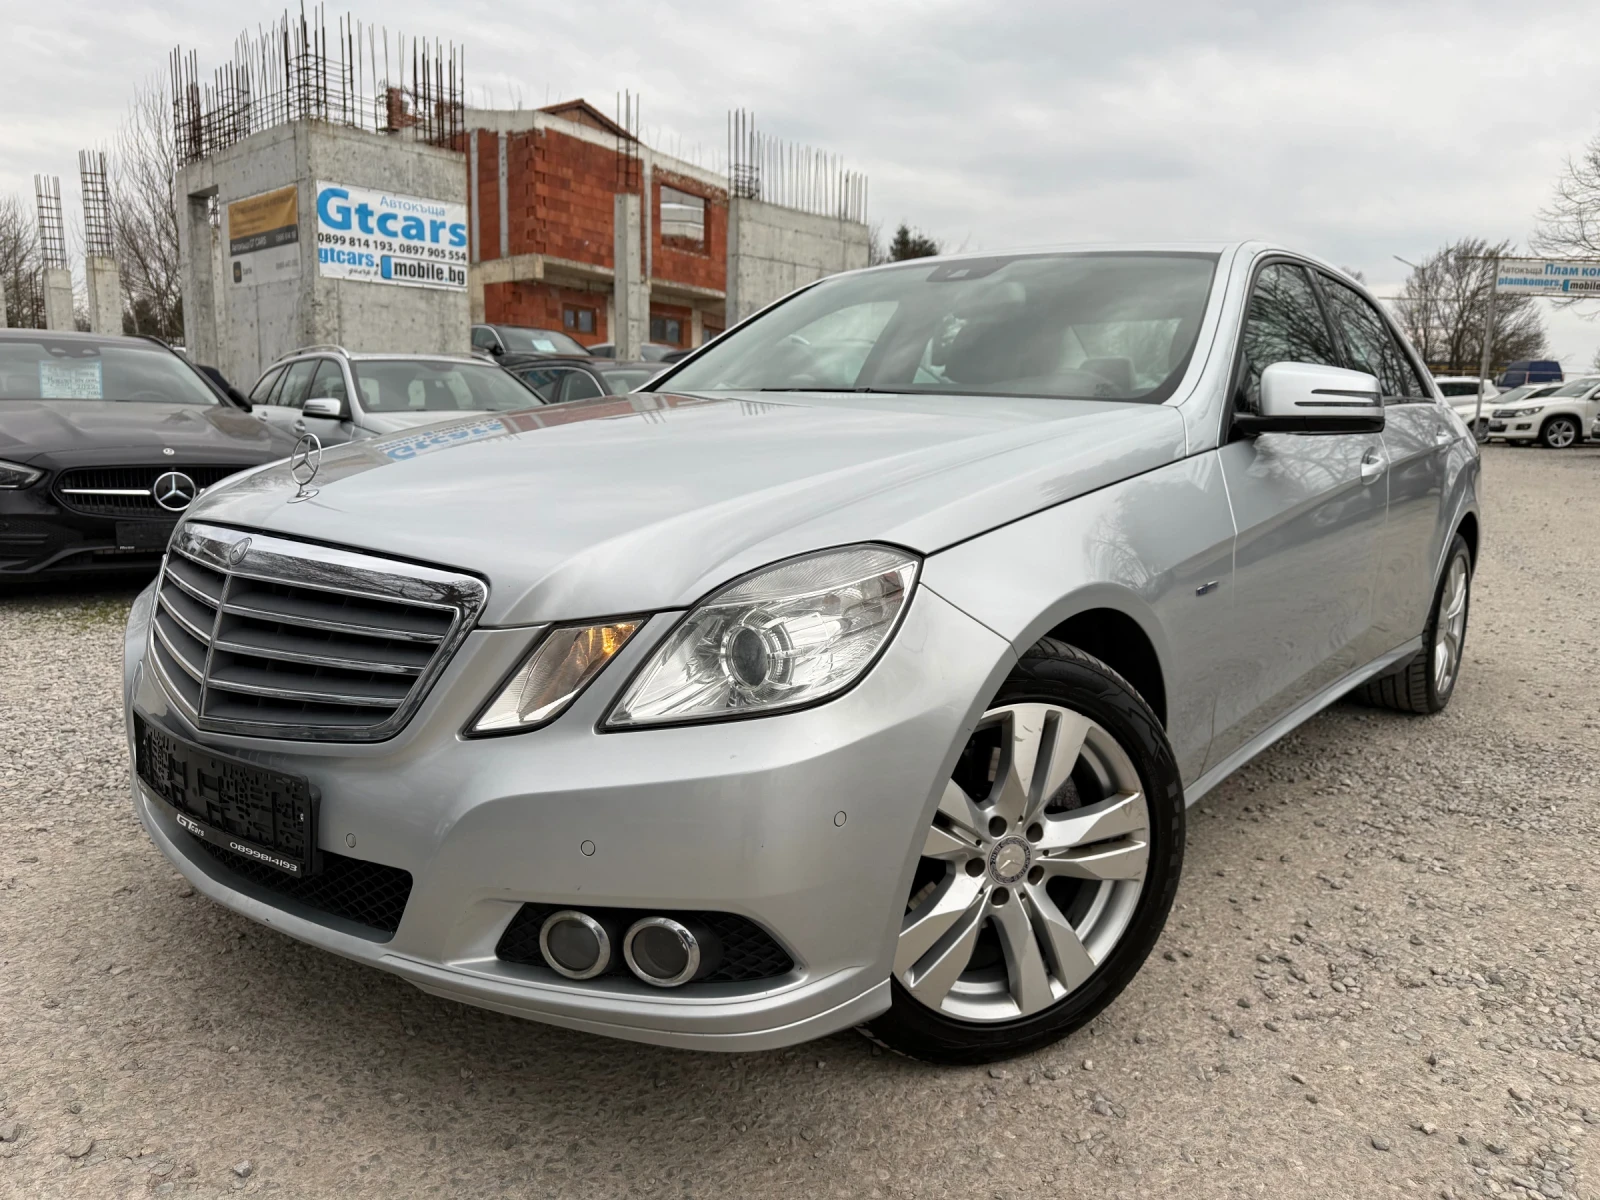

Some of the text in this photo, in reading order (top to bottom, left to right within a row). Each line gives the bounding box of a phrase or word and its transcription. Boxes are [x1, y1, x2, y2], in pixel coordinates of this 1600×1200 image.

[317, 187, 467, 247] Gtcars
[380, 195, 446, 217] Автокъща
[317, 231, 467, 261] 0899 814 193, 0897 905 554
[394, 261, 465, 285] mobile.bg
[1544, 263, 1578, 276] Плам
[229, 841, 298, 872] 0899814193
